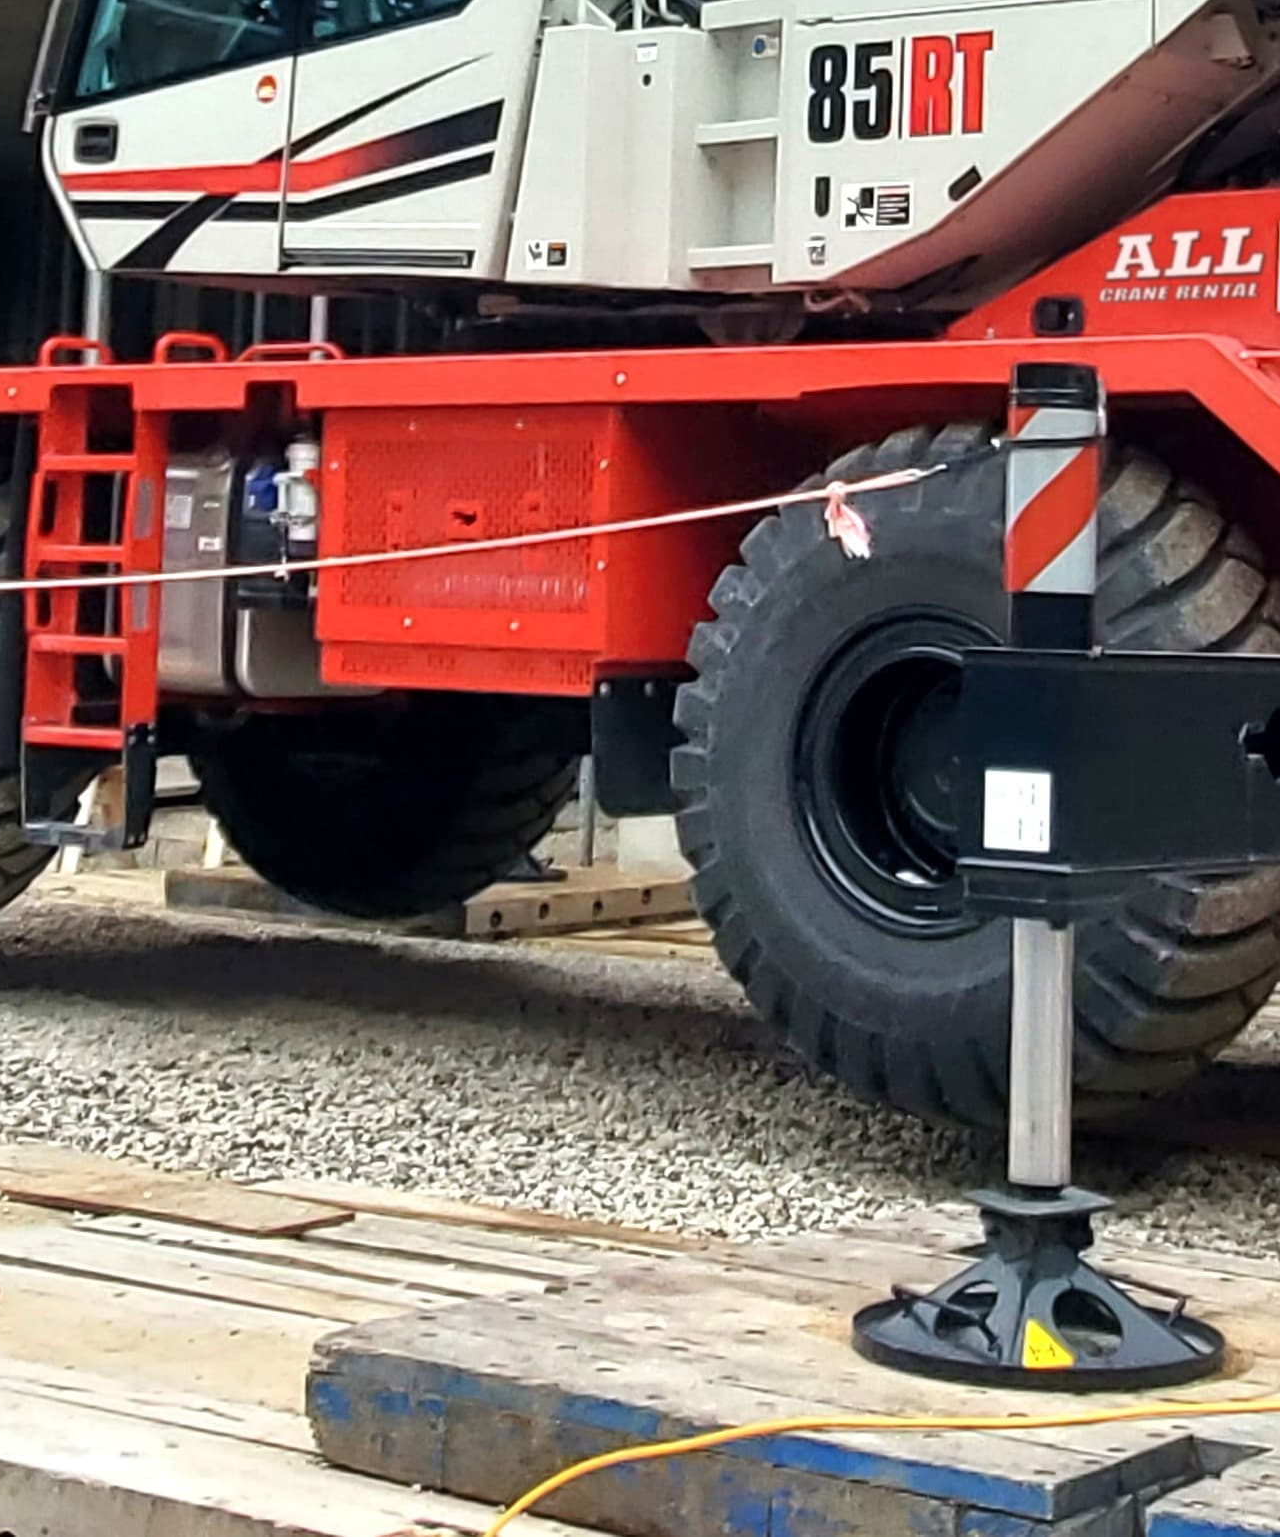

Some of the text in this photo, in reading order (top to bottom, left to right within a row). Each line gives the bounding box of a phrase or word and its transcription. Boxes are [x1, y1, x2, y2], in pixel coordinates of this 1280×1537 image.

[1105, 226, 1264, 280] ALL
[1099, 282, 1258, 303] CRANE RENTAL
